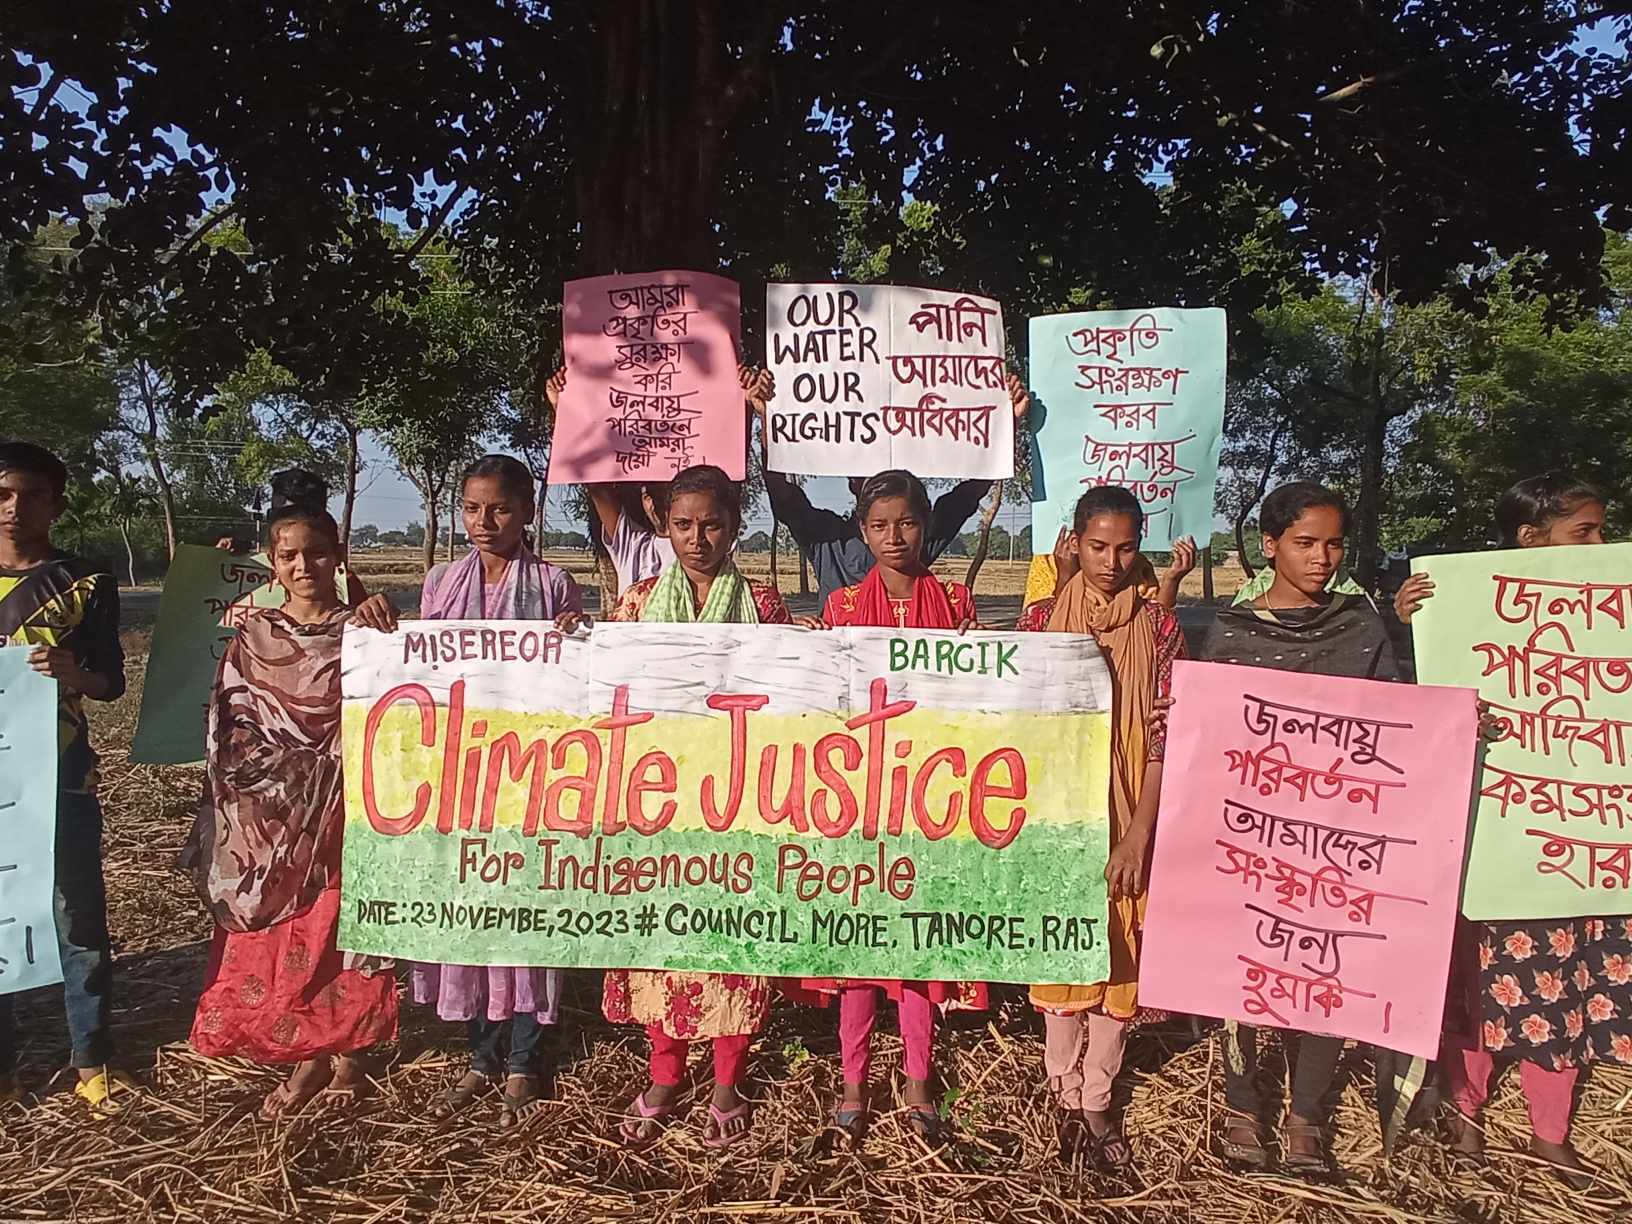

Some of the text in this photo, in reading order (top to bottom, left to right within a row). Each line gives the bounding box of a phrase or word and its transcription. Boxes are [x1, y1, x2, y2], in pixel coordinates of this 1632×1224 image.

[607, 283, 690, 312] আমরা
[787, 290, 861, 328] OUR
[908, 297, 998, 347] পানি
[602, 306, 699, 341] প্রকৃতির
[774, 326, 881, 365] WATER
[1065, 313, 1174, 364] প্রকৃতি
[614, 341, 695, 371] সুরক্ষা
[632, 361, 682, 393] করি
[885, 354, 1008, 392] আমাদের
[1074, 364, 1190, 396] সংরক্ষণ
[608, 385, 703, 419] জলবায়ু
[792, 371, 864, 404] OUR
[771, 410, 881, 445] RIGHTS
[879, 392, 998, 449] অধিকার
[1092, 401, 1174, 431] করব
[631, 433, 700, 453] আমরা
[1082, 434, 1197, 476] জলবায়ু
[1492, 574, 1632, 630] জলবা
[1471, 621, 1632, 701] পরিবত
[1243, 693, 1414, 775] জলবায়ু
[1478, 694, 1632, 768] আদিবা
[362, 677, 1027, 850] Climate Justice
[1223, 742, 1407, 814] পরিবর্তন
[1478, 762, 1632, 829] কমসং
[1222, 799, 1417, 876] আমাদের
[1525, 828, 1632, 891] হার
[459, 836, 916, 907] For Indigenous People
[1215, 838, 1429, 926] সংস্কৃতির
[1244, 902, 1388, 978] জন্য
[1237, 953, 1377, 1027] হুমকি
